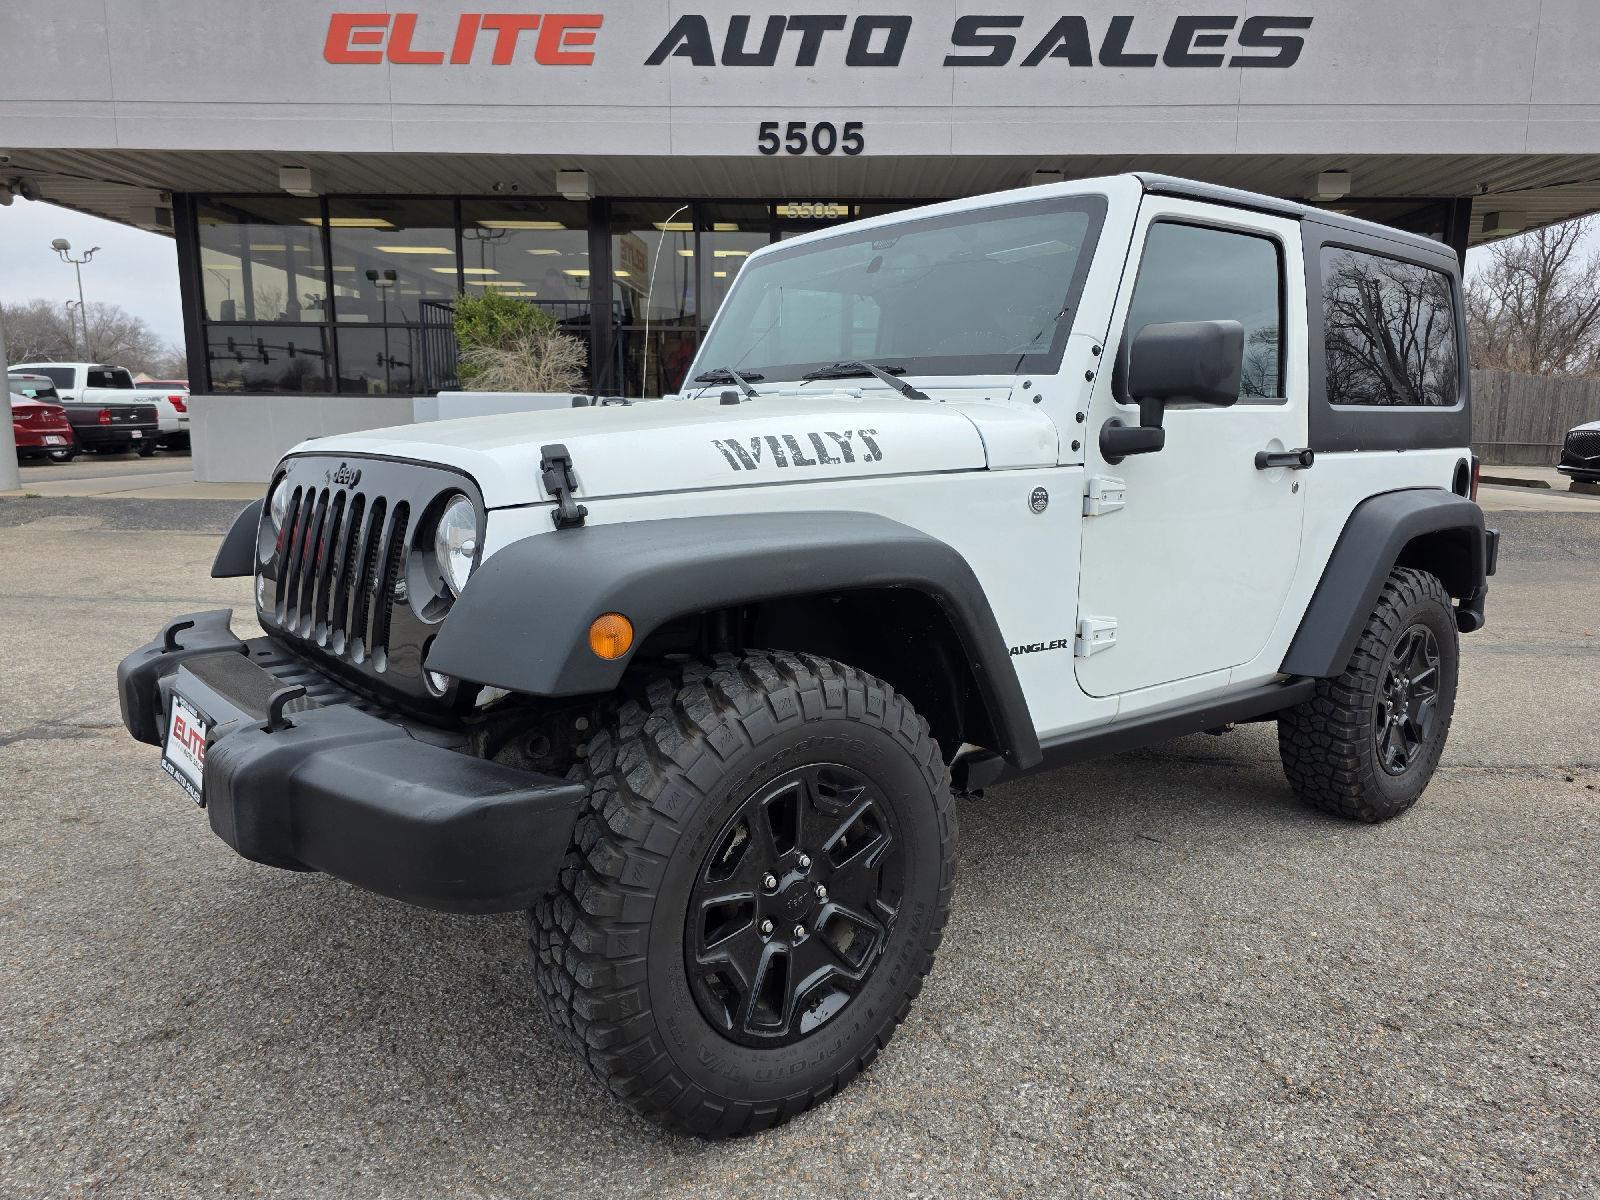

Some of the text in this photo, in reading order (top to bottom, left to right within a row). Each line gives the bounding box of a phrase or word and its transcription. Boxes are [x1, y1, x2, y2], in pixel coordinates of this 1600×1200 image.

[323, 13, 1314, 68] ELITE AUTO SALES
[757, 121, 865, 155] 5505
[787, 202, 838, 219] 5505
[710, 428, 883, 471] WILLYS
[1007, 638, 1068, 656] ANGLER
[173, 714, 205, 762] ELITE
[174, 769, 187, 786] AUTO
